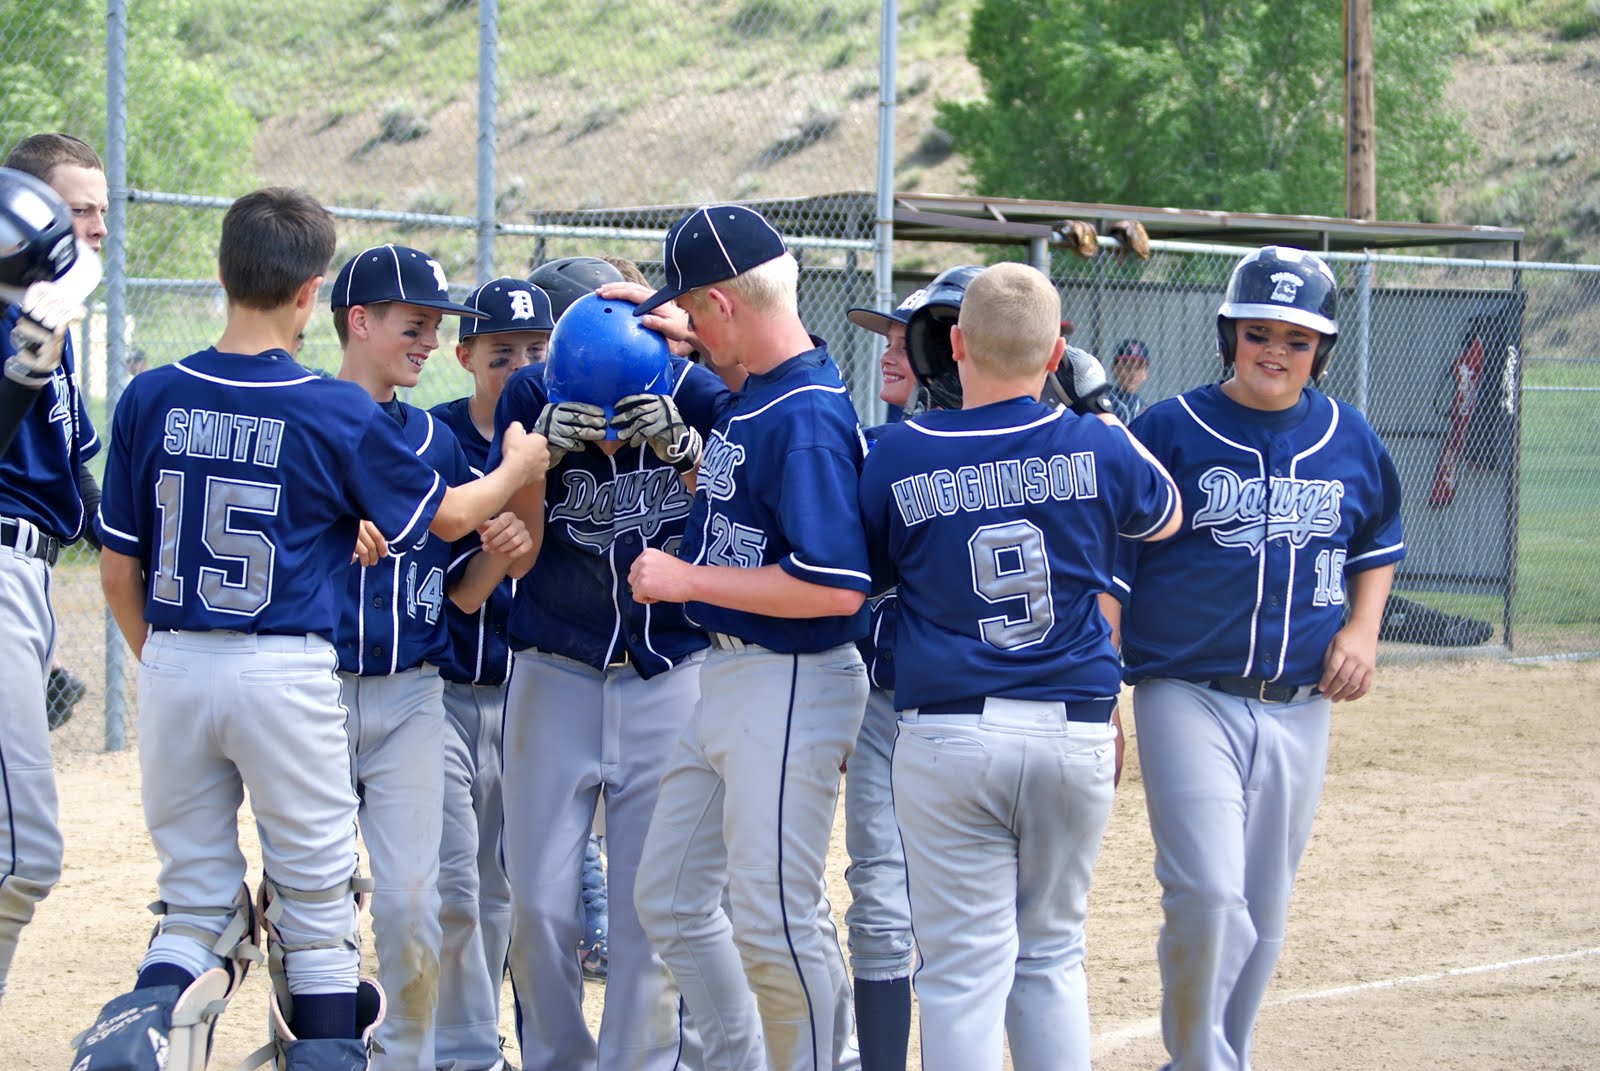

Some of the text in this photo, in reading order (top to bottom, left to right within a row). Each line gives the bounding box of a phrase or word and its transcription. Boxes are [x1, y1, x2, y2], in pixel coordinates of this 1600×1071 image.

[507, 290, 535, 320] D
[163, 408, 286, 469] SMITH
[549, 466, 696, 552] Dawgs
[891, 451, 1098, 527] HIGGINSON
[1192, 466, 1345, 556] Dawgs
[152, 469, 281, 617] 15
[706, 512, 768, 567] 25
[406, 561, 444, 625] 14
[967, 518, 1055, 651] 9
